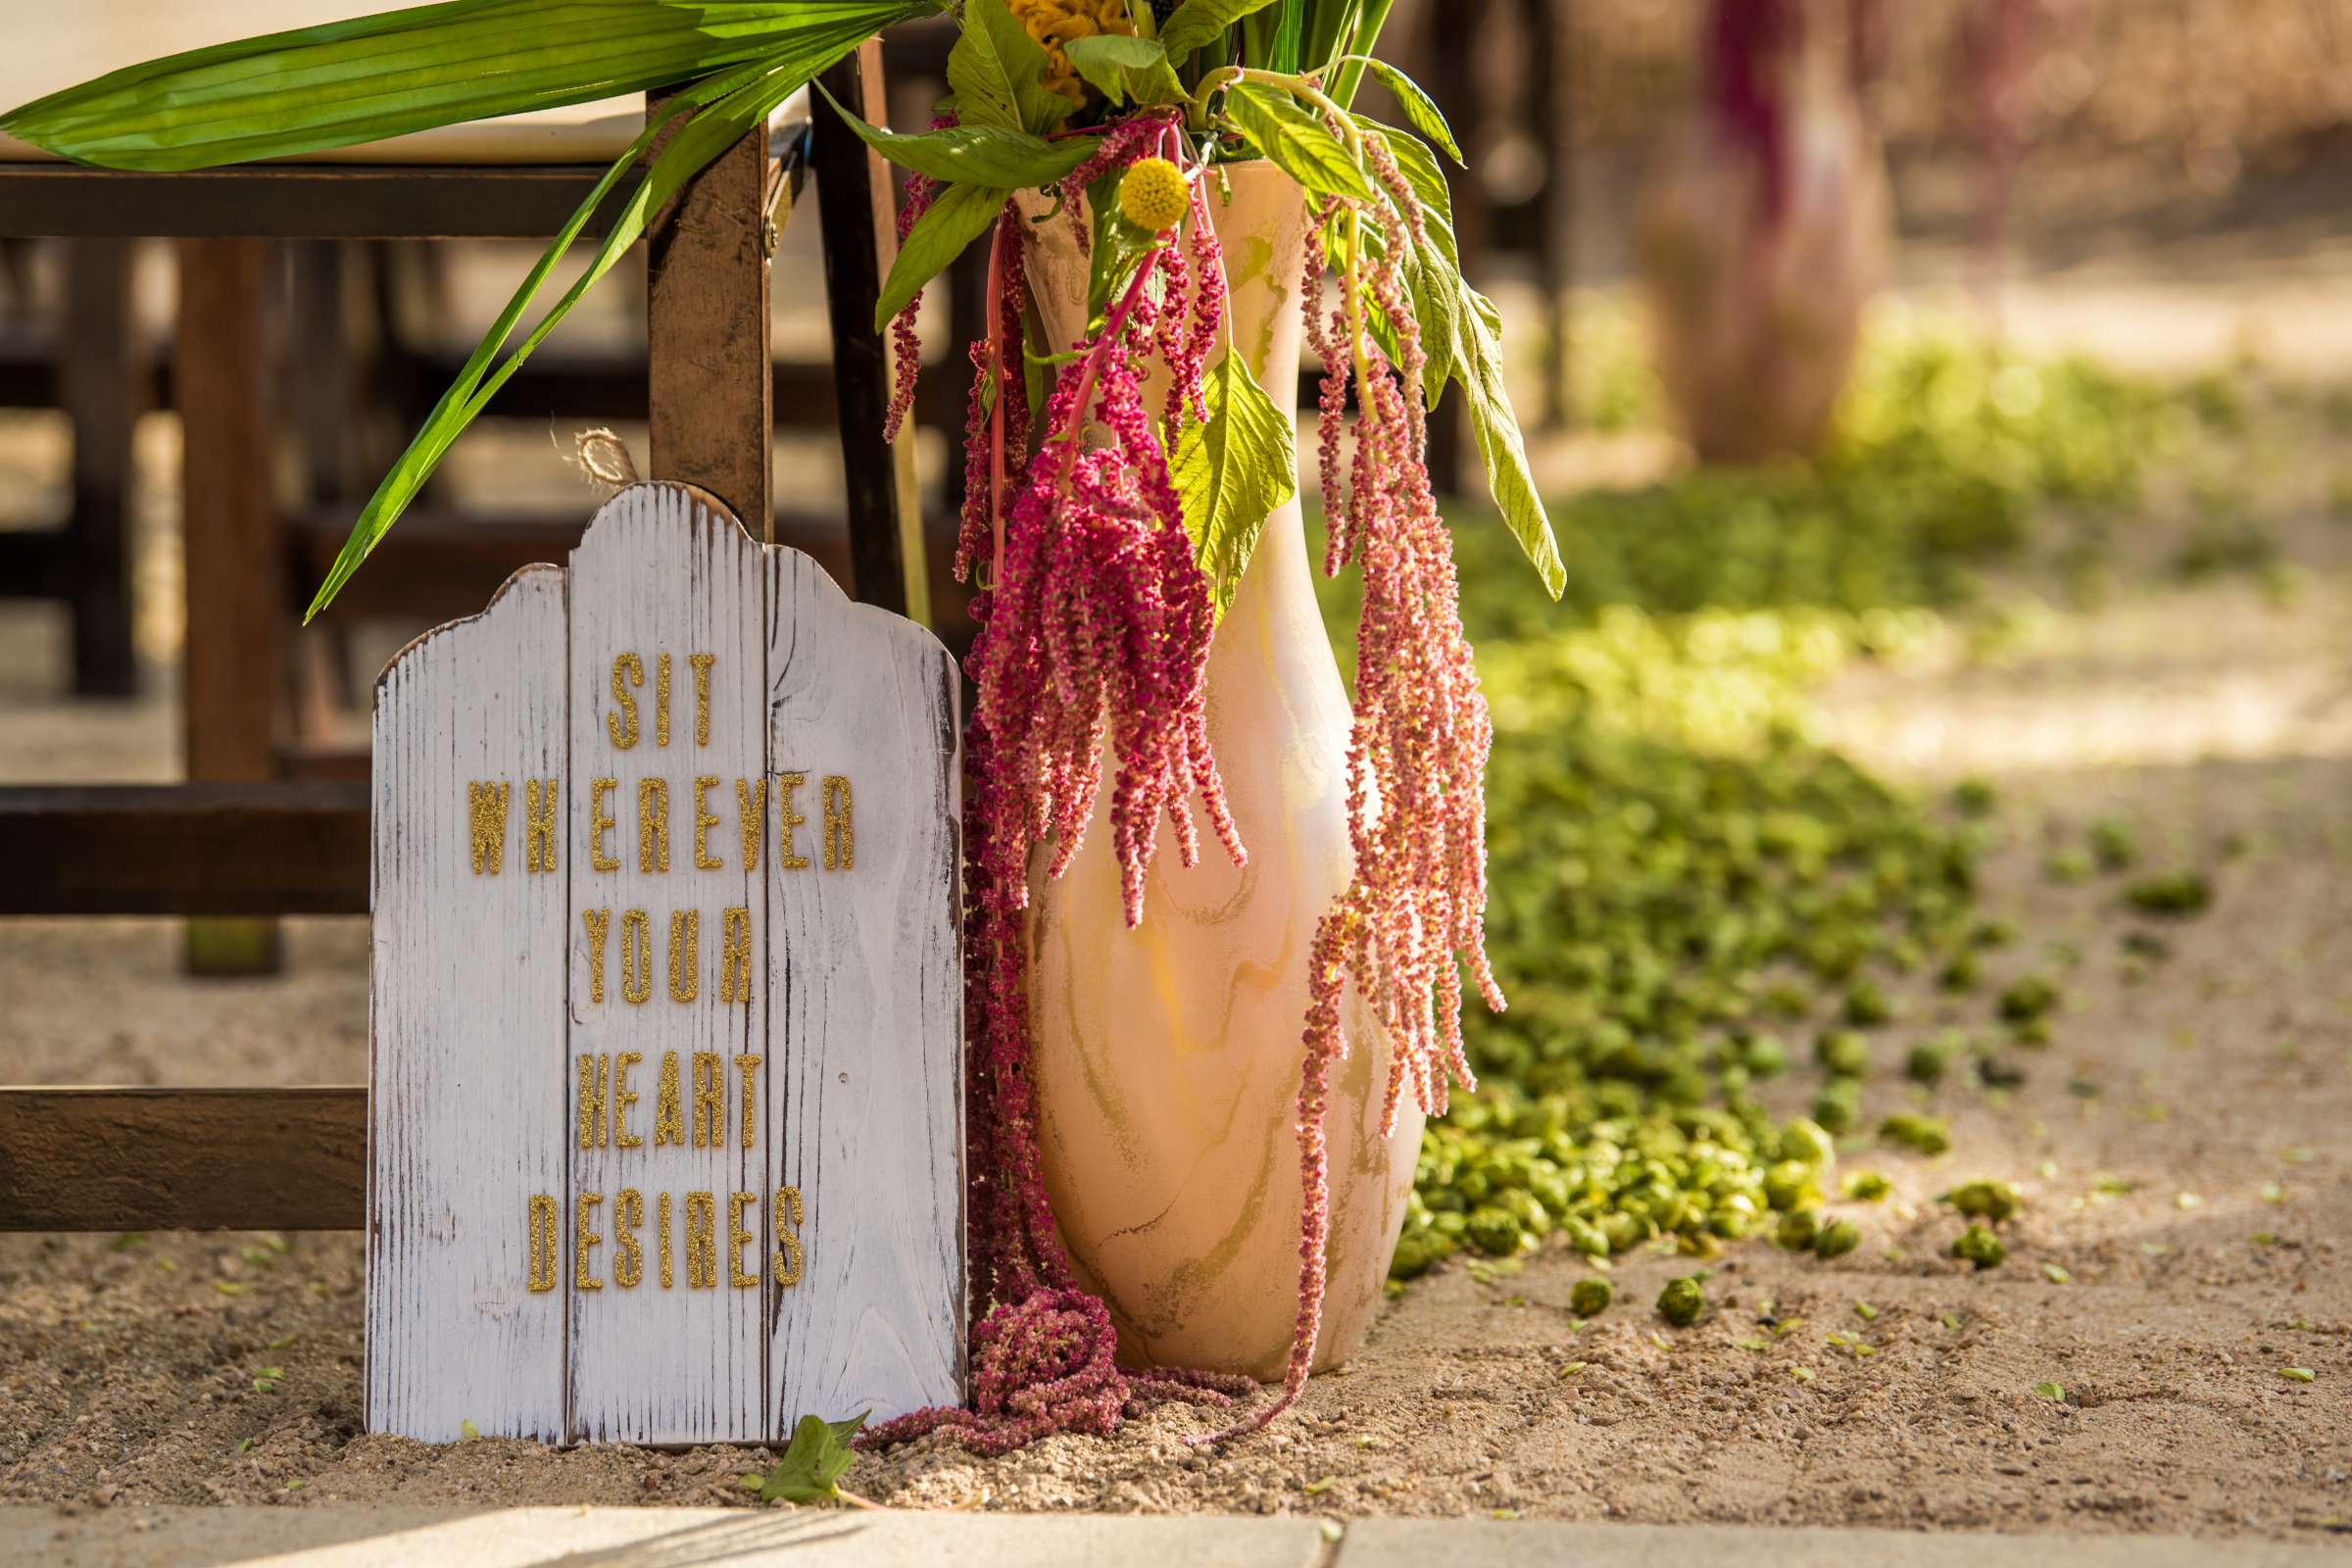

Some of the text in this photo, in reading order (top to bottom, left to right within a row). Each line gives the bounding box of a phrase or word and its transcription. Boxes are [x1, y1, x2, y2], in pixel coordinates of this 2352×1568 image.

[608, 652, 716, 750] SIT
[468, 775, 856, 874] WHEREVER
[582, 907, 752, 1004] YOUR
[579, 1052, 762, 1149] HEART
[528, 1186, 804, 1292] DESIRES
